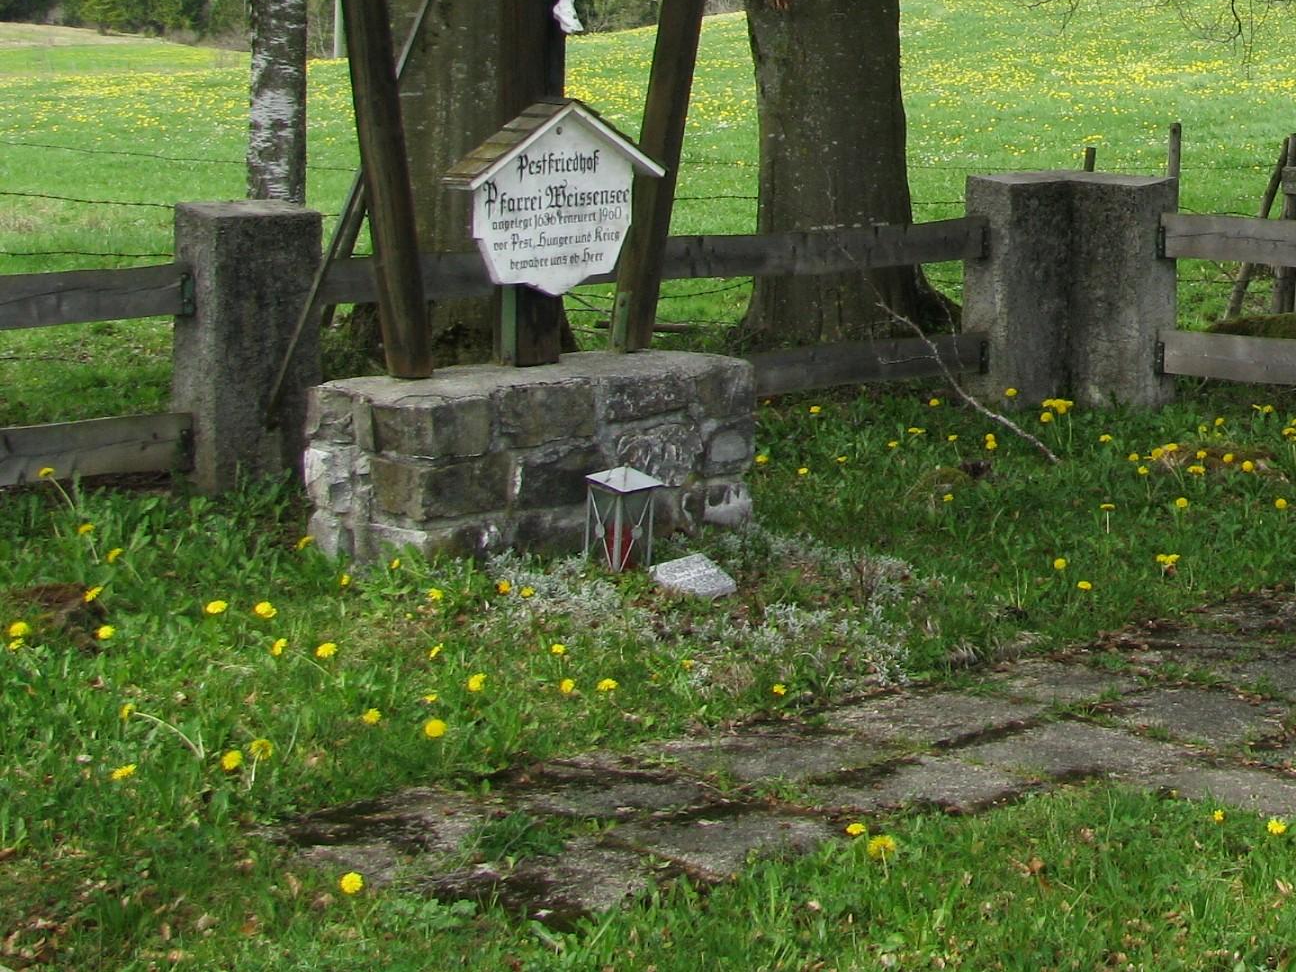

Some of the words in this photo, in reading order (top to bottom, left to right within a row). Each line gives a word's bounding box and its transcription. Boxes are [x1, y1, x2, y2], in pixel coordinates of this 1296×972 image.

[517, 150, 600, 182] Pestfriedhof
[484, 180, 542, 219] Pfarrei
[545, 179, 630, 209] Weissensee
[492, 218, 533, 232] angelegt
[493, 241, 508, 251] vor
[537, 231, 574, 248] Hunger
[575, 233, 592, 244] und
[593, 226, 620, 243] Krieg
[510, 257, 549, 270] bewahre
[550, 254, 568, 266] uns
[581, 247, 604, 263] Herr
